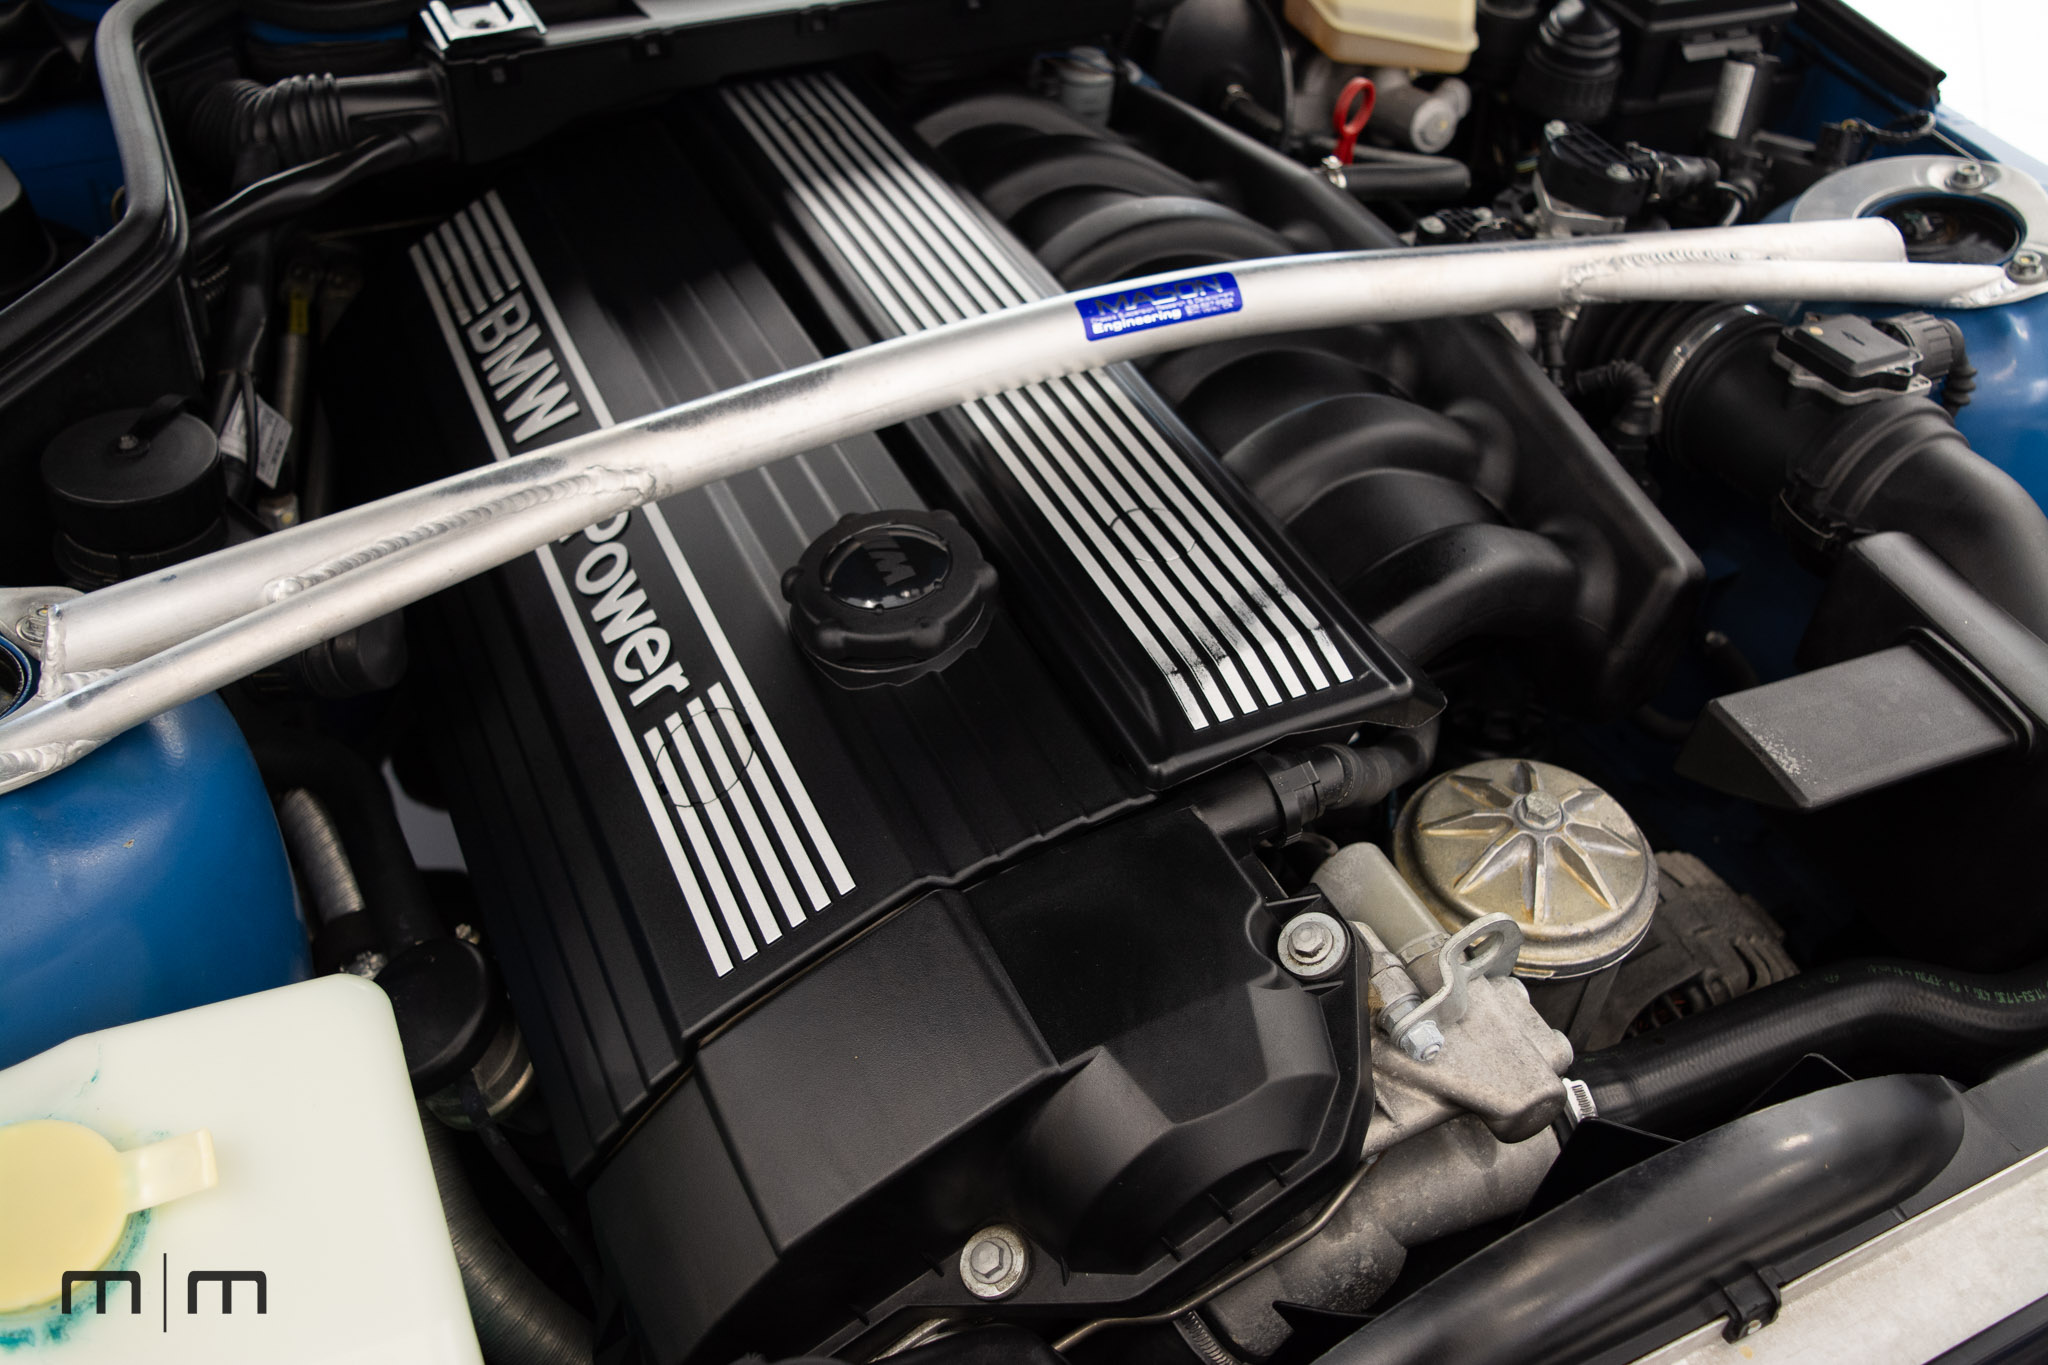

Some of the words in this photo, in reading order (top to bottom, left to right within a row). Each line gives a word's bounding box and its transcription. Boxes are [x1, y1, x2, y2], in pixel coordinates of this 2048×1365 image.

[1095, 277, 1223, 315] MASON
[1092, 308, 1182, 335] Engineering
[467, 291, 580, 444] BMW
